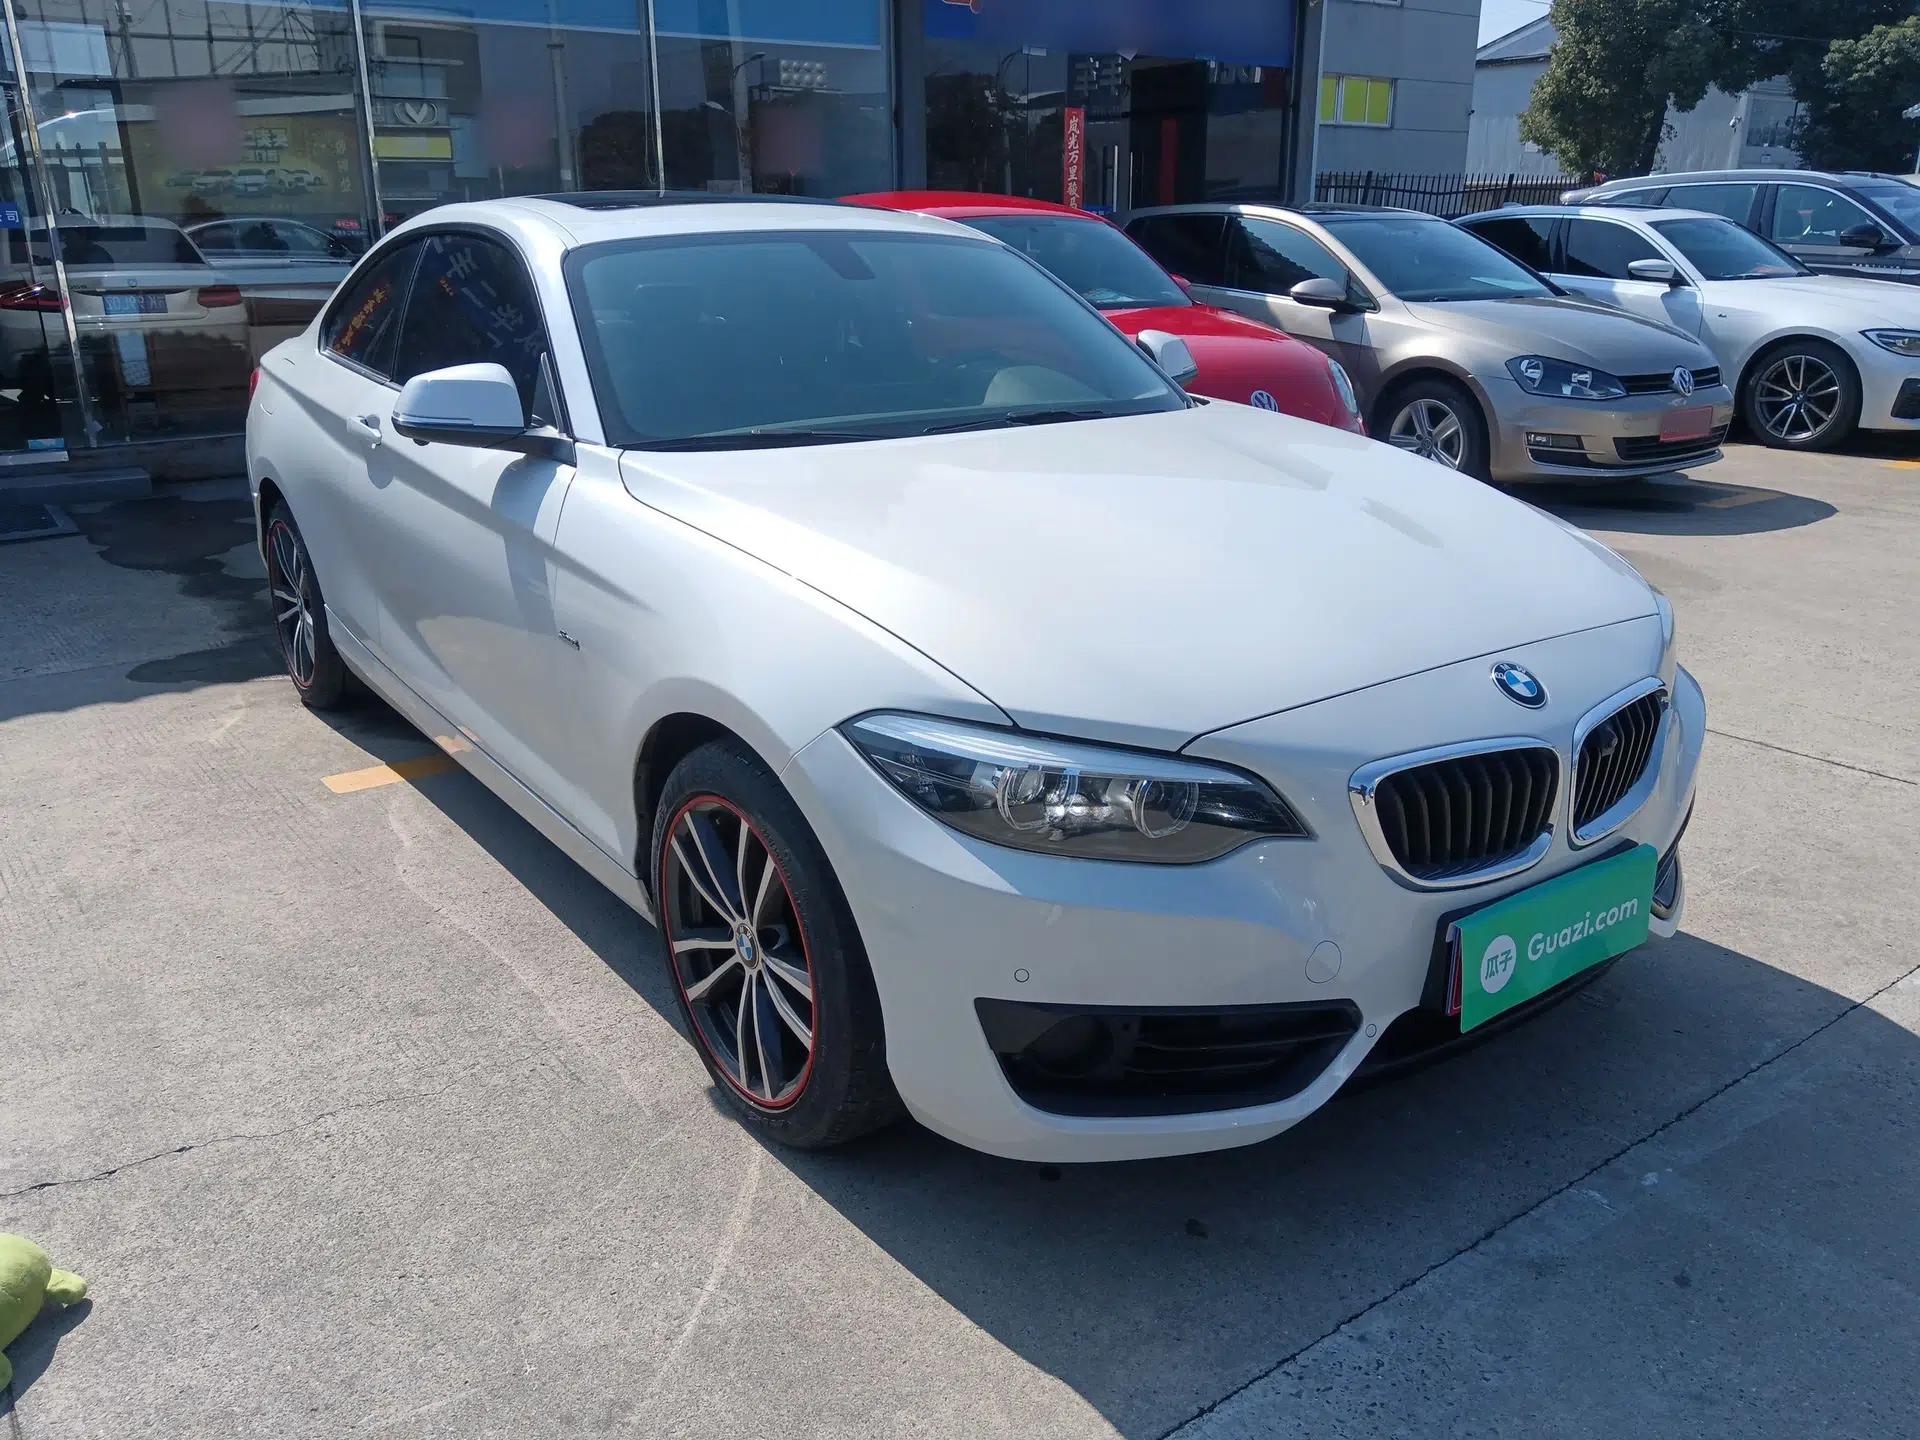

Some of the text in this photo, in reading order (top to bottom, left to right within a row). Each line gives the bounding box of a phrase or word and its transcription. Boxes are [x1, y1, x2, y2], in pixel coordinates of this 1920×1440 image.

[0, 210, 20, 223] 司
[1494, 663, 1526, 680] BMW
[1527, 898, 1639, 962] Guazi.com
[1484, 948, 1513, 981] 瓜子
